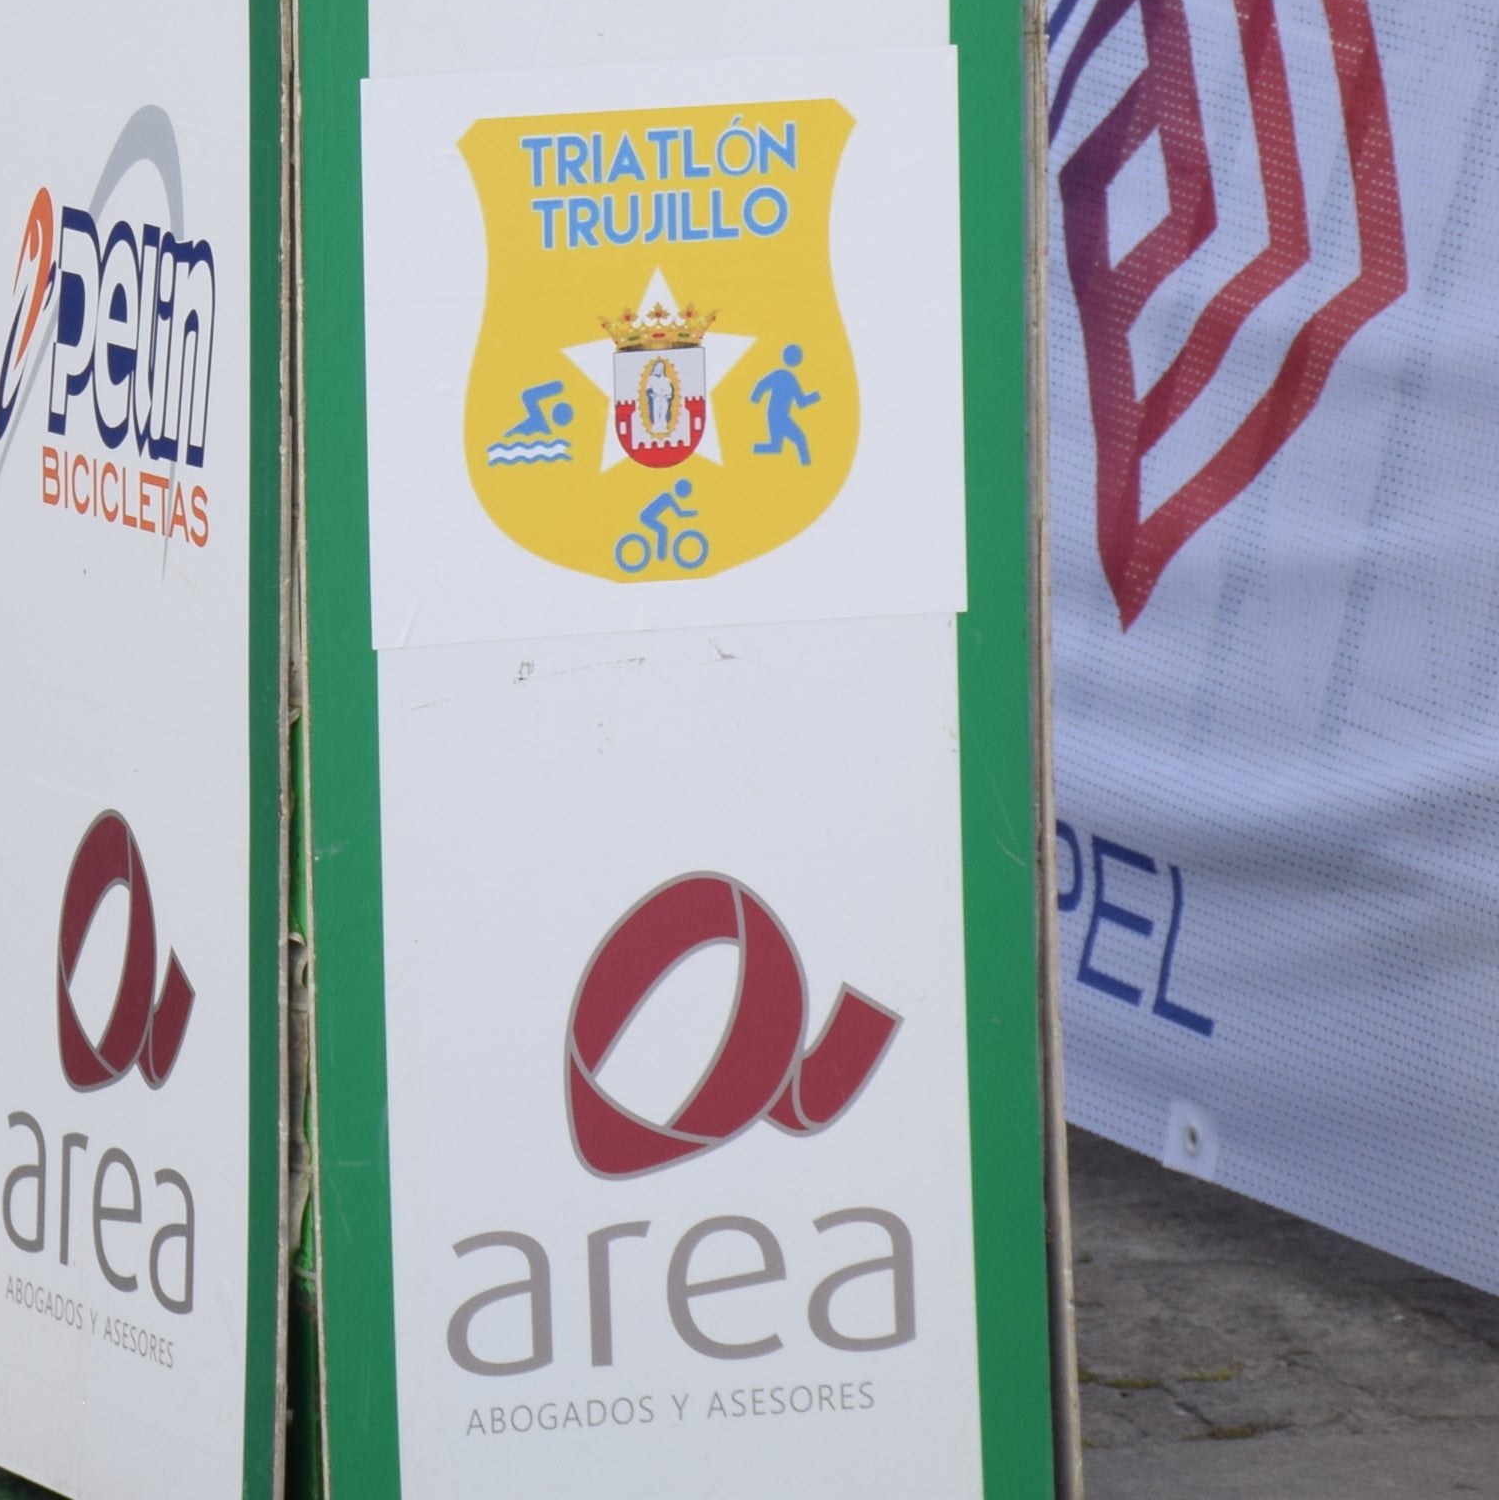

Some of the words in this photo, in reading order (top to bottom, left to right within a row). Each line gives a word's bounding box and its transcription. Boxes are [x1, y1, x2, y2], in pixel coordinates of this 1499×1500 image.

[521, 114, 796, 186] TRIATLÓN
[532, 187, 789, 249] TRUJILLO
[41, 445, 209, 548] BICICLETAS
[2, 1110, 196, 1316] area
[5, 1275, 84, 1330] ABOGADOS
[89, 1307, 100, 1336] Y
[103, 1315, 175, 1369] ASESORES
[446, 1206, 917, 1378] area
[465, 1395, 655, 1437] ABOGADOS
[670, 1393, 690, 1421] Y
[706, 1380, 876, 1419] ASESORES
